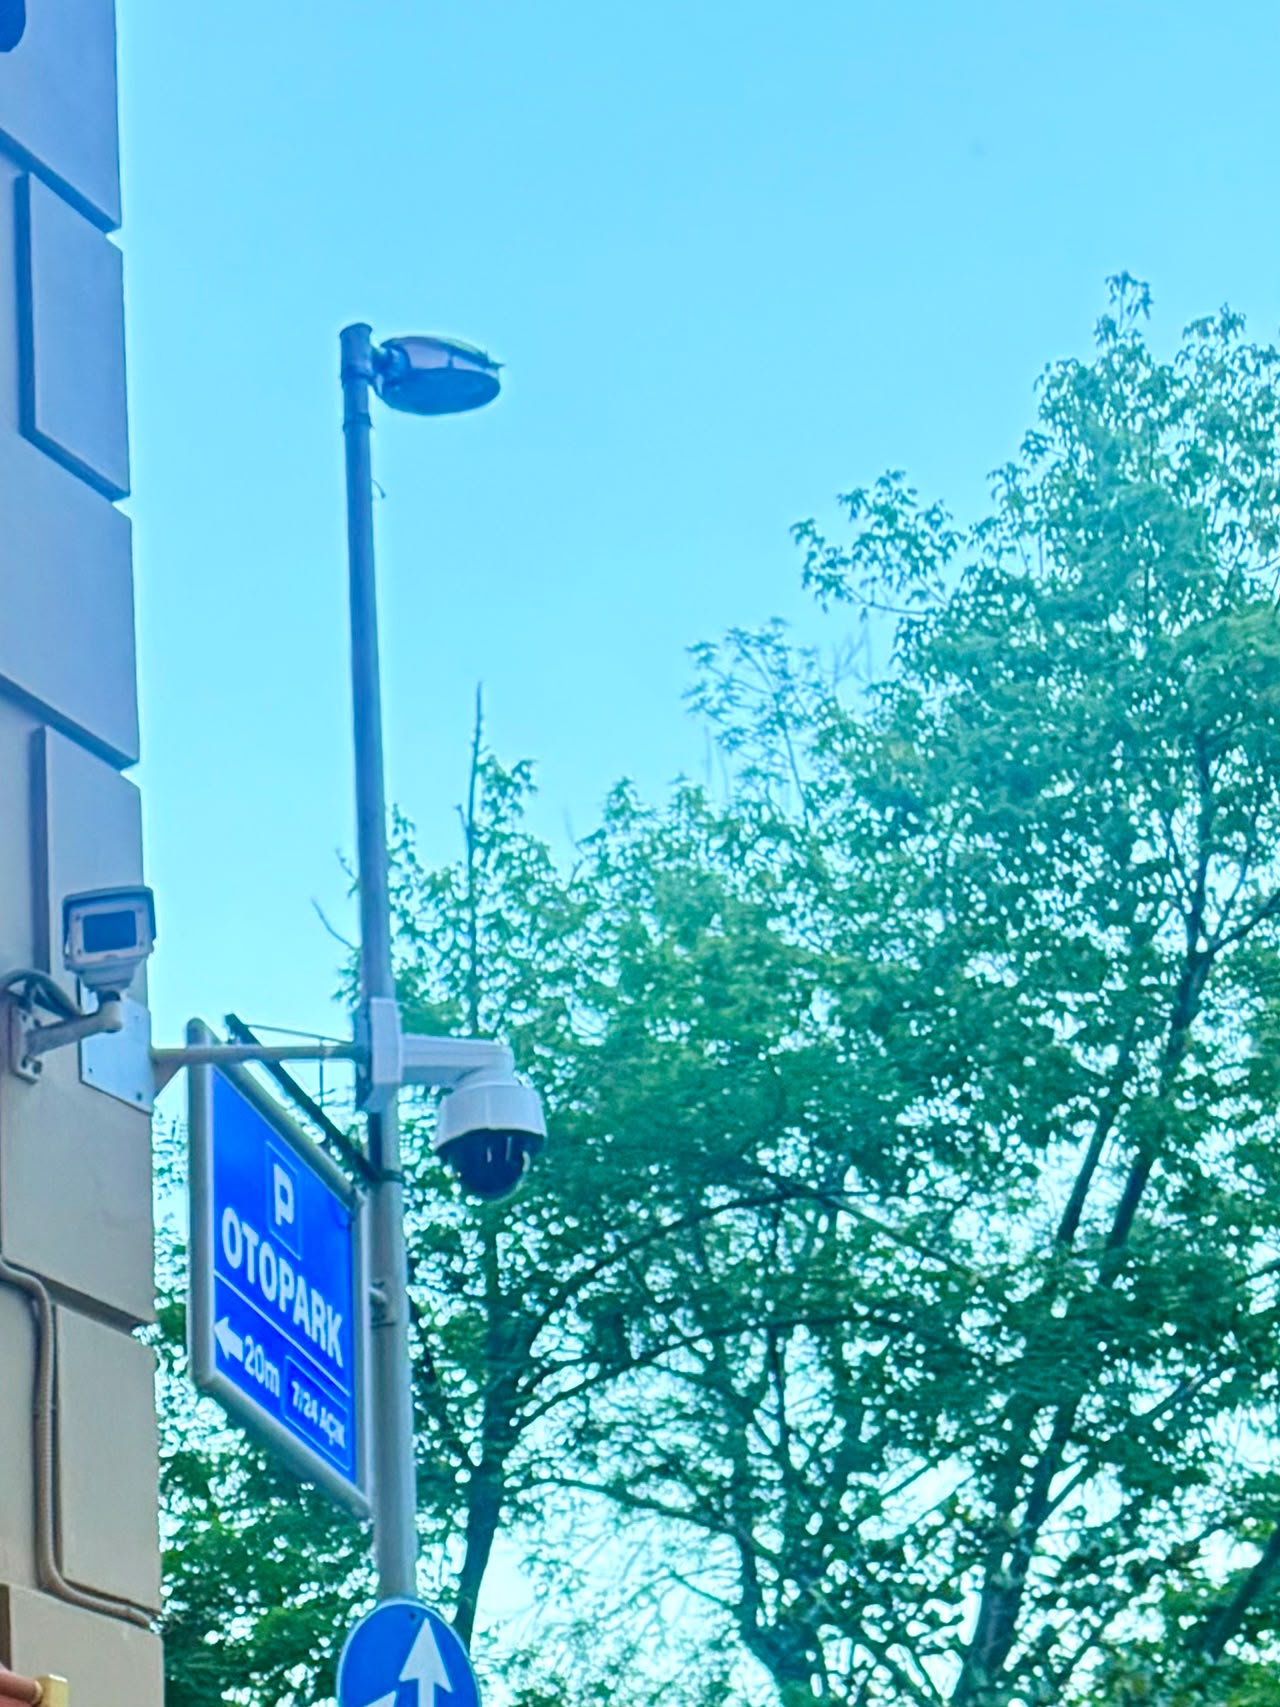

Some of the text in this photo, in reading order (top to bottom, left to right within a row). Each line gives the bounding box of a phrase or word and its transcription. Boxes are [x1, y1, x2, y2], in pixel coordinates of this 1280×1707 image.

[273, 1162, 295, 1229] P
[221, 1206, 344, 1369] OTOPARK
[244, 1335, 280, 1398] 20m
